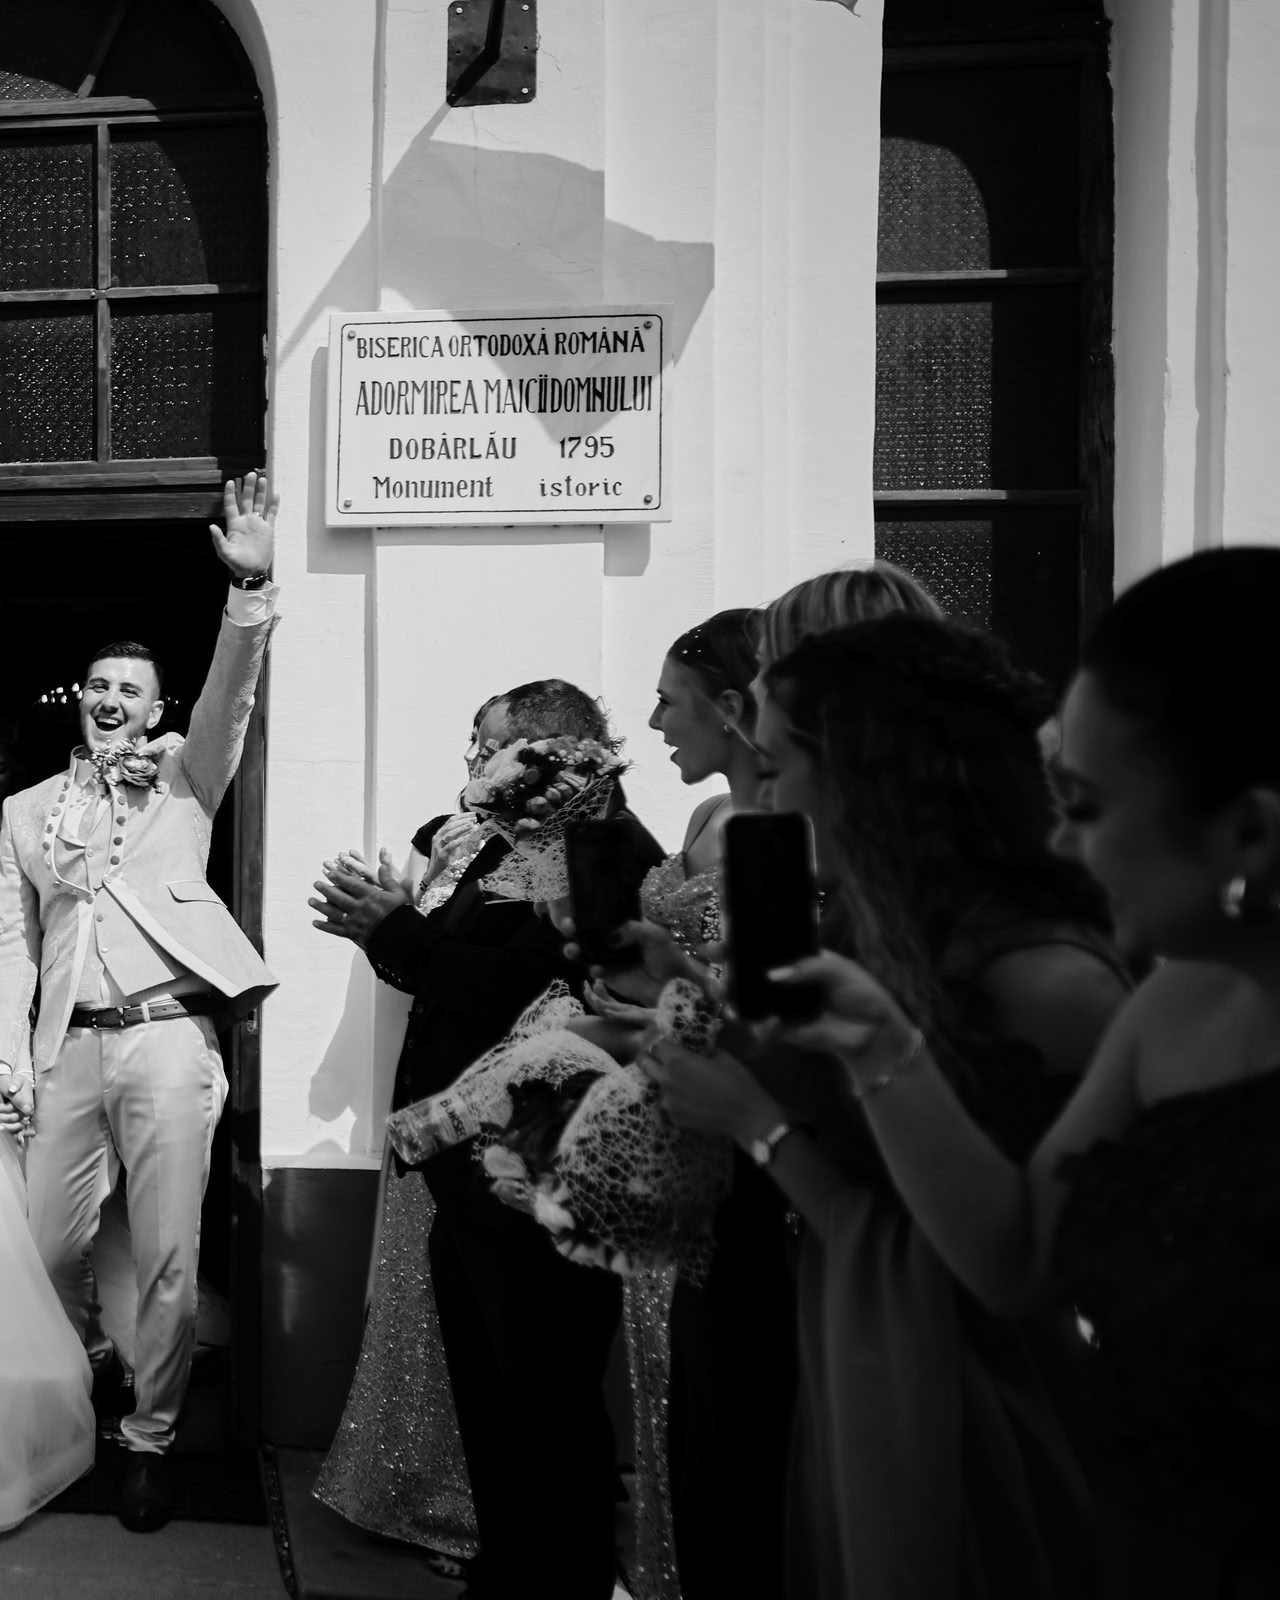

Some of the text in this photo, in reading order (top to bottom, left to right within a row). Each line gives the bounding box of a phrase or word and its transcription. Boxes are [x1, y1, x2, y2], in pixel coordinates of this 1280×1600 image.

[356, 335, 444, 358] BISERICA
[356, 379, 479, 416] ADORMIREA
[550, 375, 653, 413] DOMNULUI
[560, 435, 615, 459] 1795
[372, 475, 623, 499] Monument istoric
